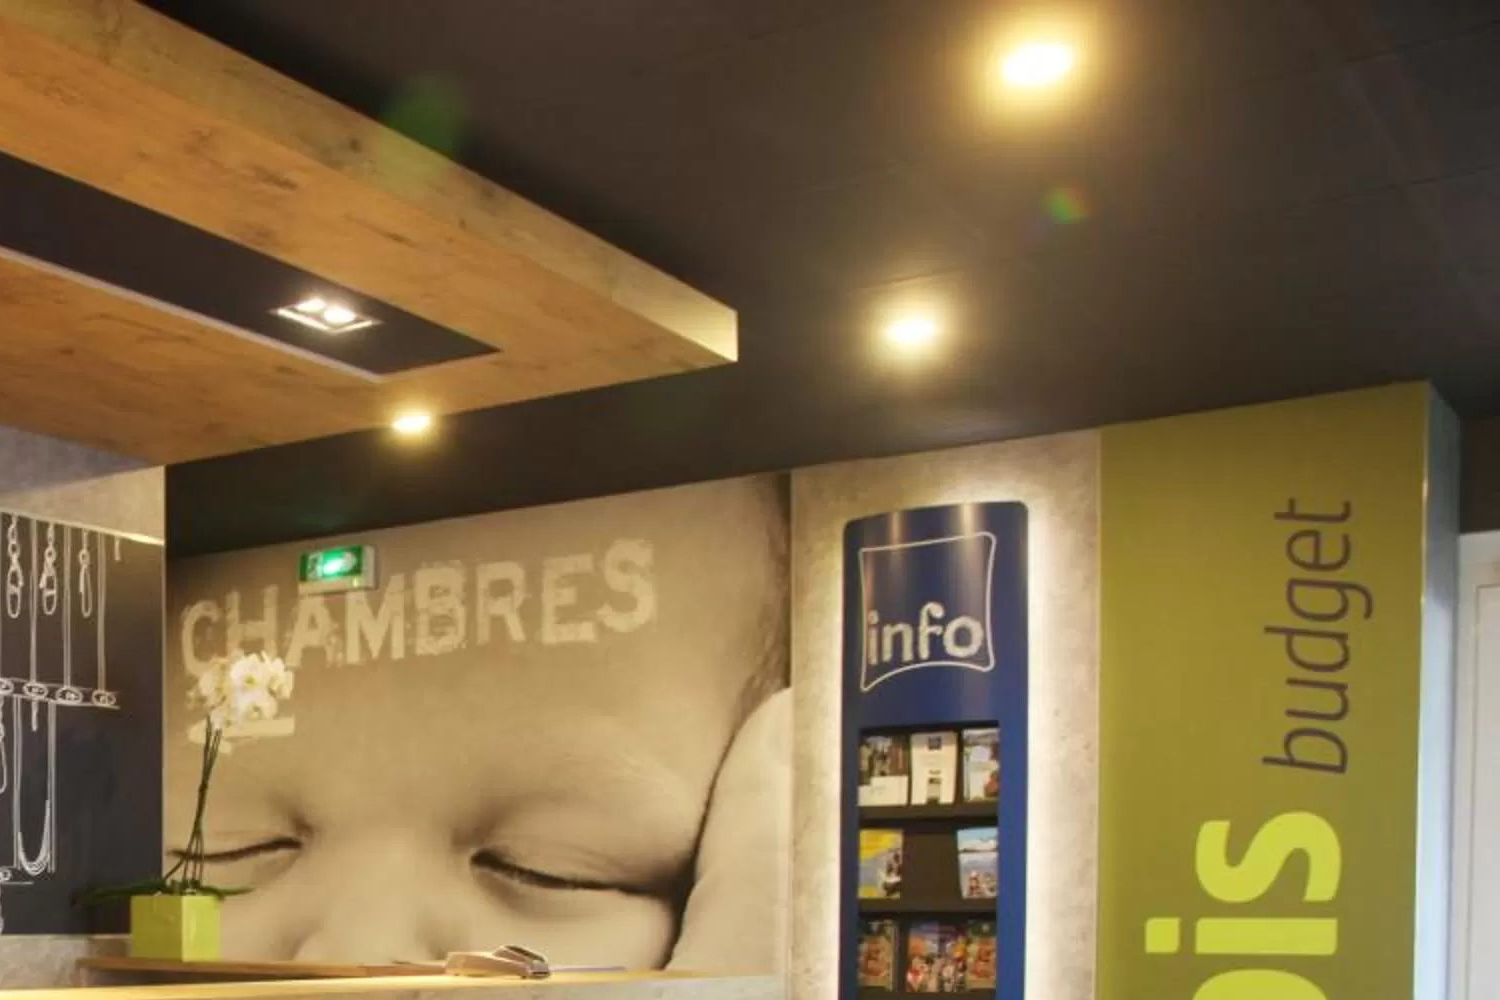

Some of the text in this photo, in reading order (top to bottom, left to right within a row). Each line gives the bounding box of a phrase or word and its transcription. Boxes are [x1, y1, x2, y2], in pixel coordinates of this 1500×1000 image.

[181, 538, 657, 677] CHAMBRES
[867, 601, 984, 665] info
[1262, 497, 1372, 774] budget
